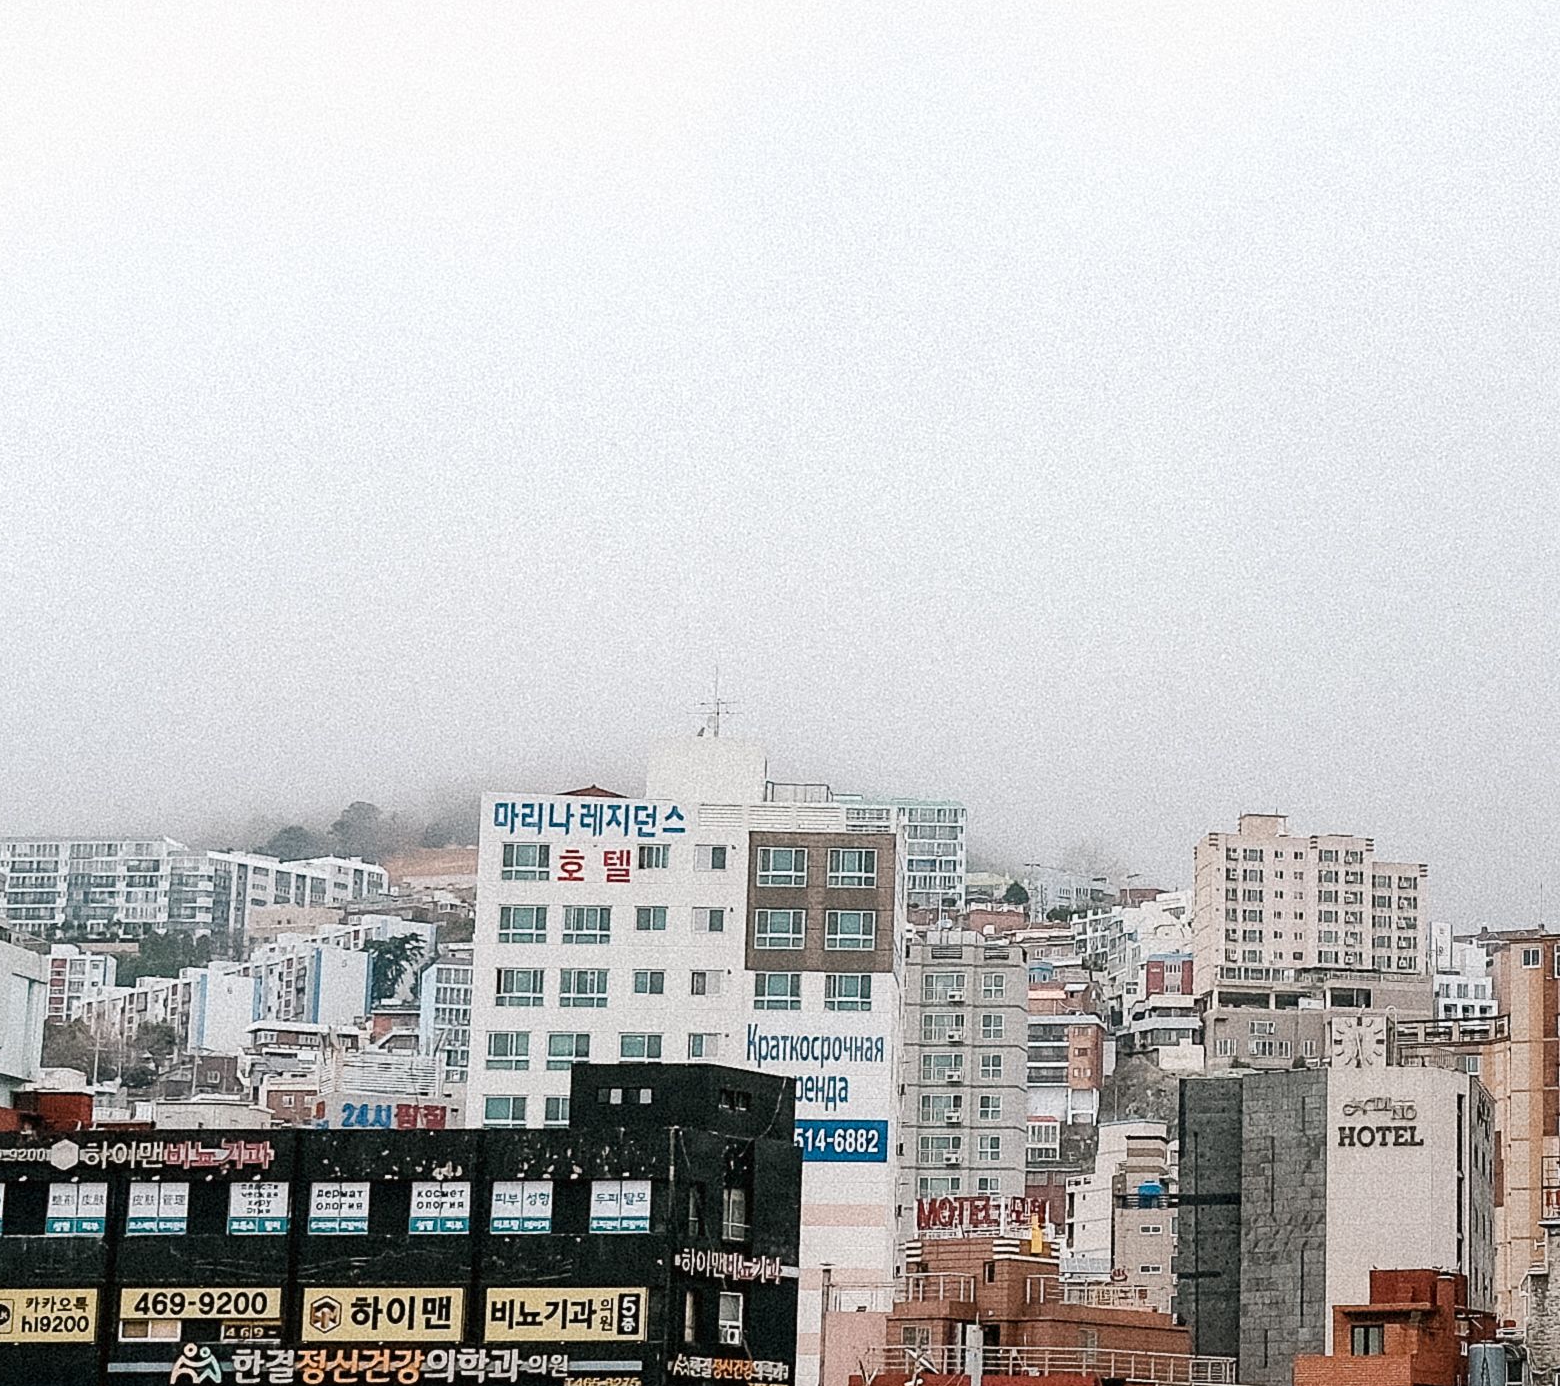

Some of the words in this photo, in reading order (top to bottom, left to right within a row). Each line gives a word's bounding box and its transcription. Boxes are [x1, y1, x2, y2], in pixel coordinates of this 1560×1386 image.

[493, 803, 574, 836] 마리나
[580, 803, 686, 837] 레지던스
[557, 849, 631, 883] 호텔
[747, 1024, 884, 1066] Краткосрочная
[794, 1077, 849, 1111] ренда
[1337, 1125, 1425, 1148] HOTEL
[916, 1198, 998, 1231] MOTEL
[25, 1295, 90, 1313] 카카오톡
[133, 1291, 269, 1316] 469-9200
[350, 1294, 453, 1331] 하이맨
[490, 1297, 597, 1330] 비뇨기과
[231, 1348, 519, 1386] 한결정신건강의학과
[527, 1354, 570, 1377] 의원
